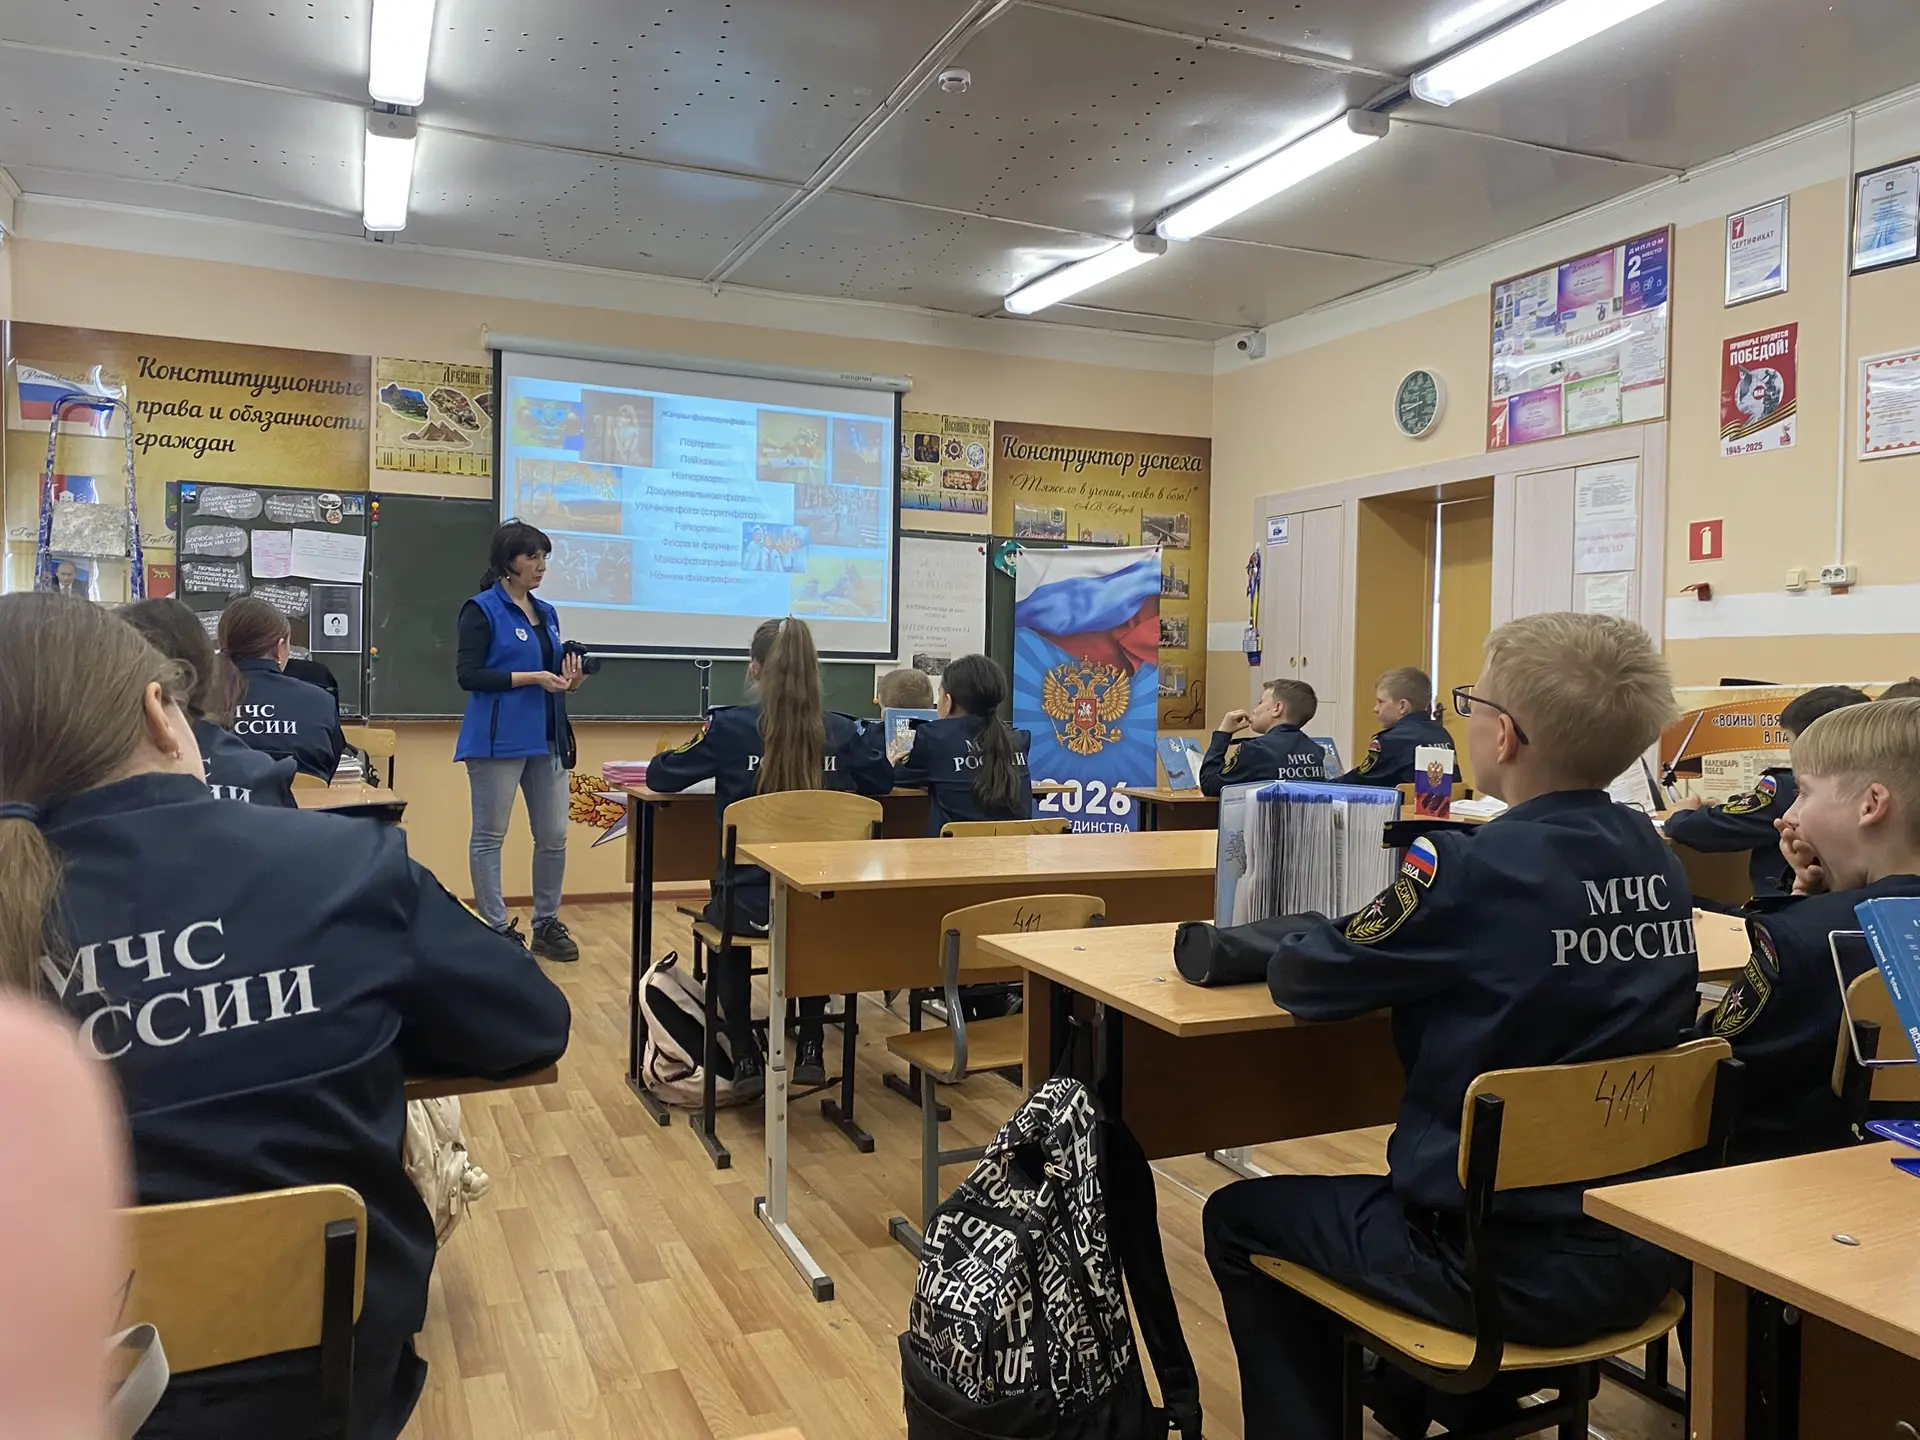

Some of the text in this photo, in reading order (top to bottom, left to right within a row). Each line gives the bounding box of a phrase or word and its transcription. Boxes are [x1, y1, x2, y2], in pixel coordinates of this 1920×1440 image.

[1628, 237, 1665, 255] ДИПЛОМ
[1731, 230, 1774, 250] СЕРТИФИКАТ
[1627, 247, 1662, 279] 2 МЕСТО
[1729, 329, 1789, 351] ПРИМОРЬЕ ГОРДИТСЯ
[1729, 339, 1789, 366] ПОБЕДОЙ!
[137, 356, 365, 397] Конституционные
[136, 399, 366, 433] права и обязанности
[135, 432, 236, 458] граждан
[1002, 436, 1203, 478] Конструктор успеха
[671, 470, 724, 483] Натюрморт
[646, 485, 721, 500] Документальное
[1079, 483, 1087, 495] в
[1088, 488, 1125, 502] учении,
[1128, 488, 1155, 500] легко
[1158, 487, 1165, 499] в
[234, 720, 298, 735] ССИИ
[1712, 713, 1780, 728] «ВОЙНЫ СВЯ
[1764, 731, 1790, 744] В ПА
[1287, 753, 1316, 765] МЧС
[1704, 759, 1739, 768] КАЛЕНДАРЬ
[1038, 778, 1132, 817] 2026
[1402, 862, 1420, 878] SSIA
[1397, 881, 1413, 910] ССИИ
[1580, 873, 1671, 917] МЧС
[40, 917, 227, 1000] МЧС
[77, 964, 322, 1062] ССИИ
[1594, 1064, 1656, 1128] 411
